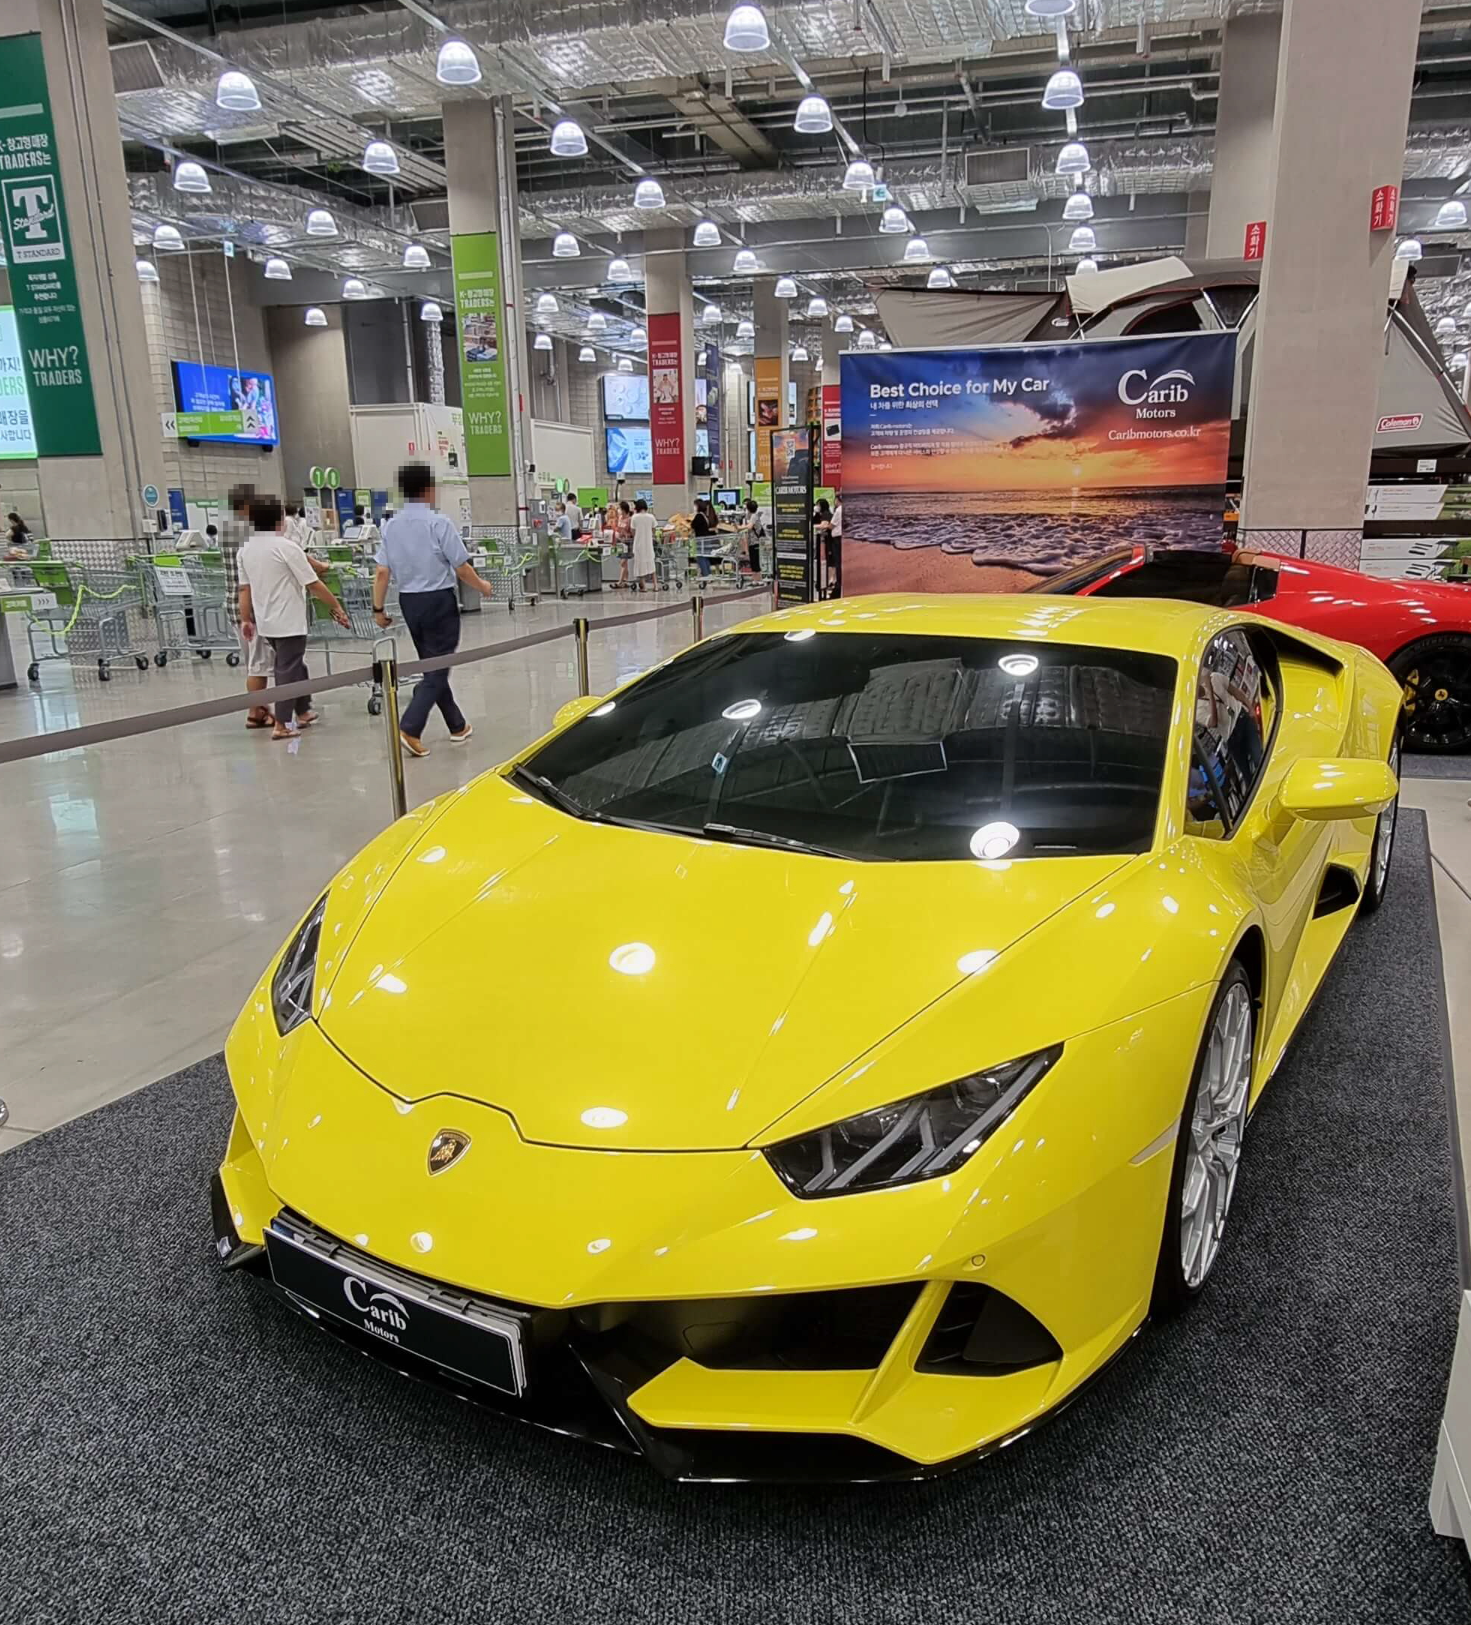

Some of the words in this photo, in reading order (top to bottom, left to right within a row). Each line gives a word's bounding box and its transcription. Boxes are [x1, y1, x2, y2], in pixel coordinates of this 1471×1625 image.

[12, 186, 48, 239] T
[1373, 189, 1384, 227] 소화기
[1248, 224, 1261, 258] 소화기
[23, 248, 60, 258] STANDARD
[28, 346, 78, 369] WHY?
[33, 369, 82, 386] TRADERS
[1118, 369, 1190, 405] Carib
[870, 384, 905, 398] Best
[908, 380, 962, 396] Choice
[966, 380, 989, 394] for
[993, 379, 1017, 395] My
[1021, 377, 1050, 391] Car
[468, 411, 501, 424] WHY?
[1136, 408, 1176, 419] Motors
[1380, 417, 1413, 429] Coleman
[470, 425, 502, 435] TRADERS
[1108, 426, 1201, 440] Caribmotors.co.kr
[655, 438, 680, 448] WHY?
[343, 1276, 406, 1330] Carib
[363, 1318, 399, 1343] Motors
